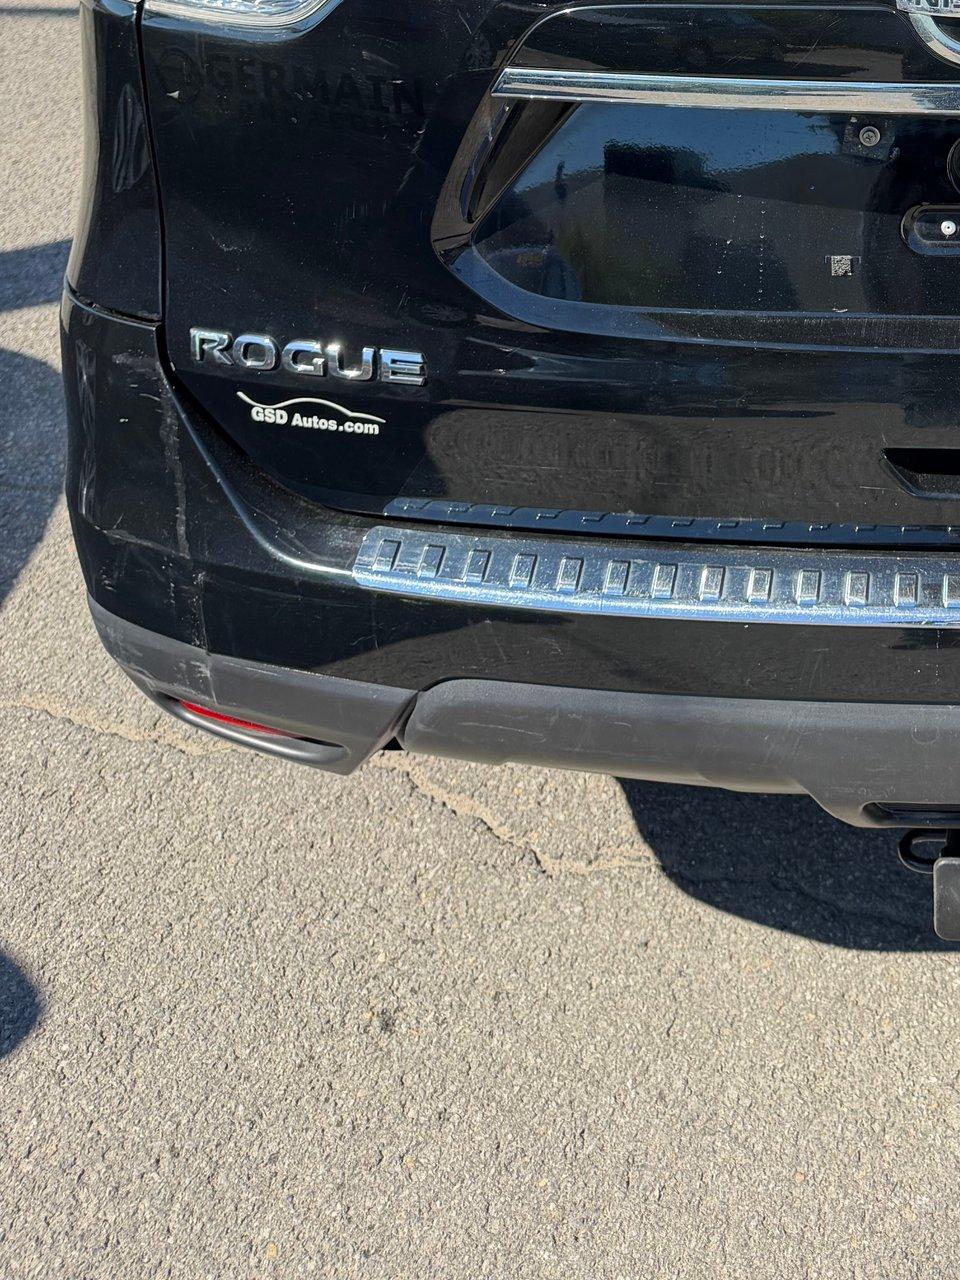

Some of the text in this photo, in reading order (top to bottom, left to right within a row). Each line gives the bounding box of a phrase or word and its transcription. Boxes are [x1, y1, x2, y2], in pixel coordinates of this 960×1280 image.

[207, 54, 427, 116] GERMAIN
[189, 327, 428, 387] ROGUE
[250, 406, 380, 436] GSD Autos.com
